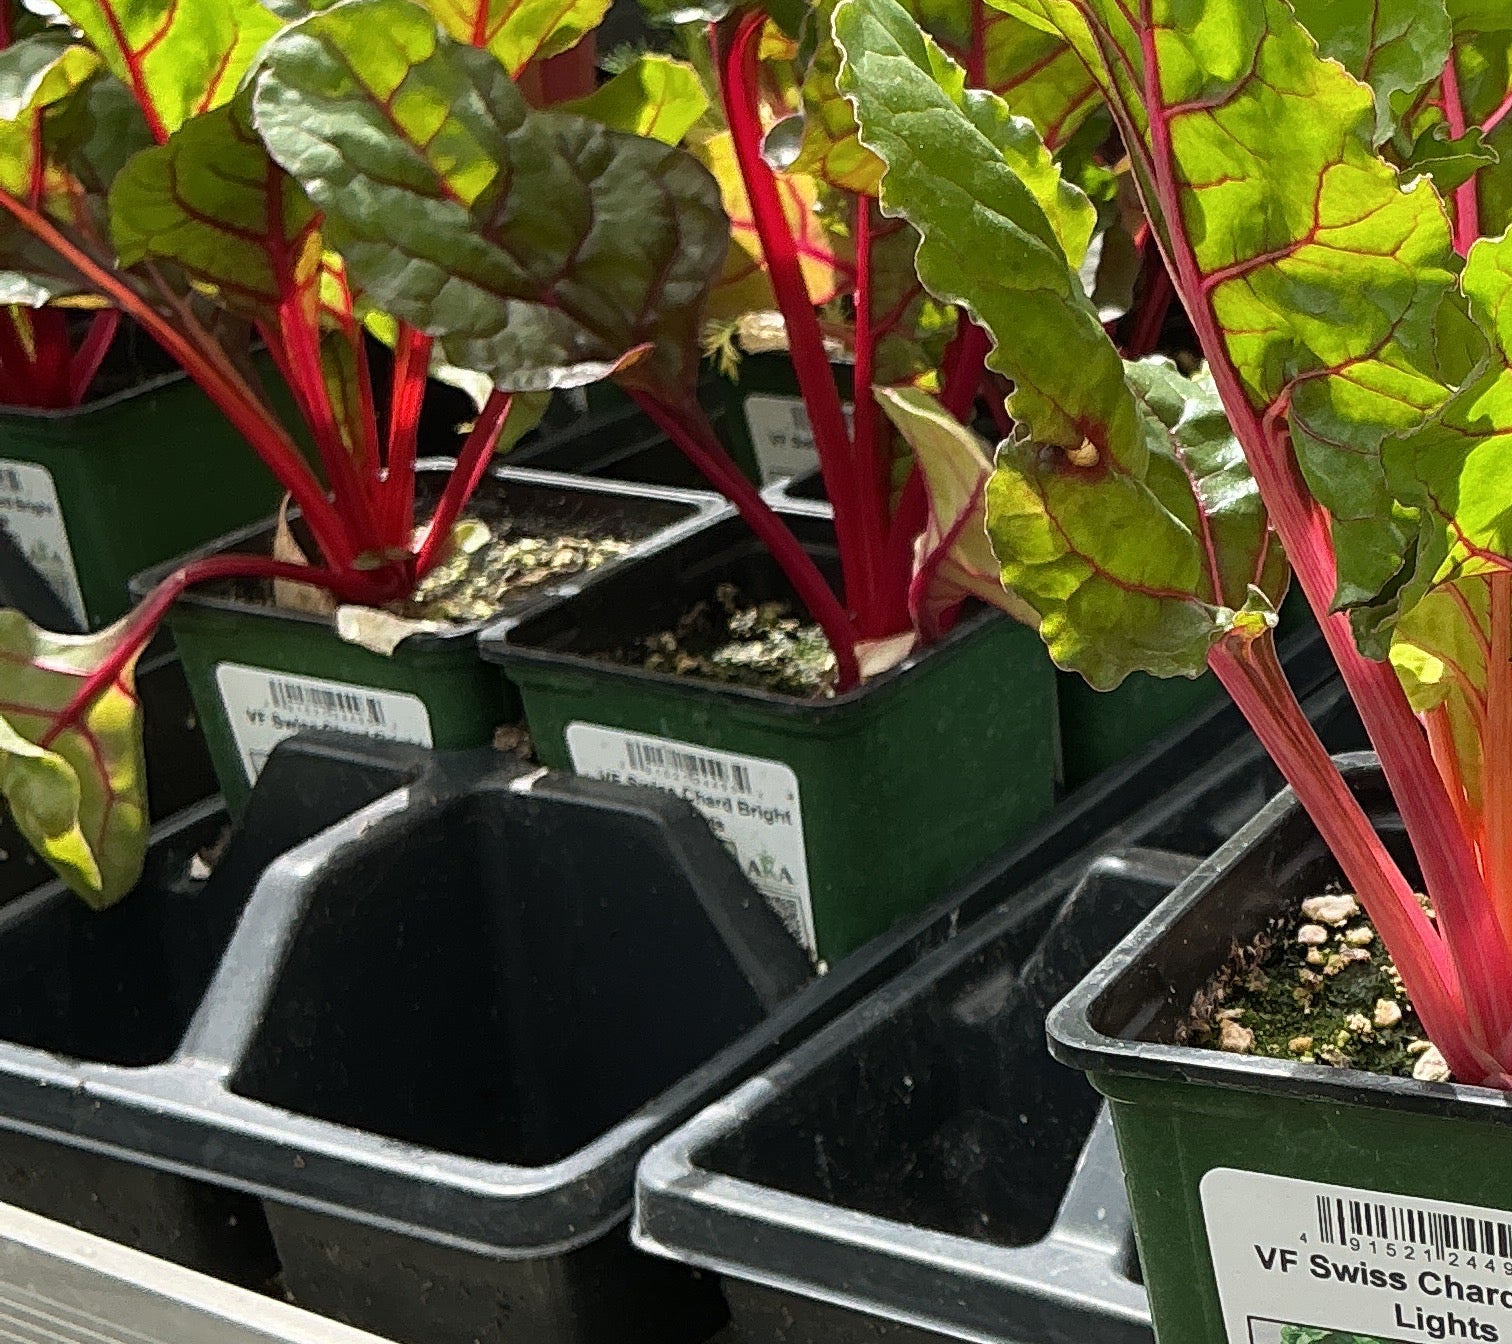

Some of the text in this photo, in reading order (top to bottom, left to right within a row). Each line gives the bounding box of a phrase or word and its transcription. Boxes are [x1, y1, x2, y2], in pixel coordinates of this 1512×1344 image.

[737, 799, 794, 827] Bright
[1299, 1232, 1308, 1244] 4
[1349, 1237, 1432, 1263] 91521
[1253, 1244, 1298, 1273] VF
[1309, 1253, 1408, 1292] Swiss
[1394, 1302, 1499, 1343] Lights
